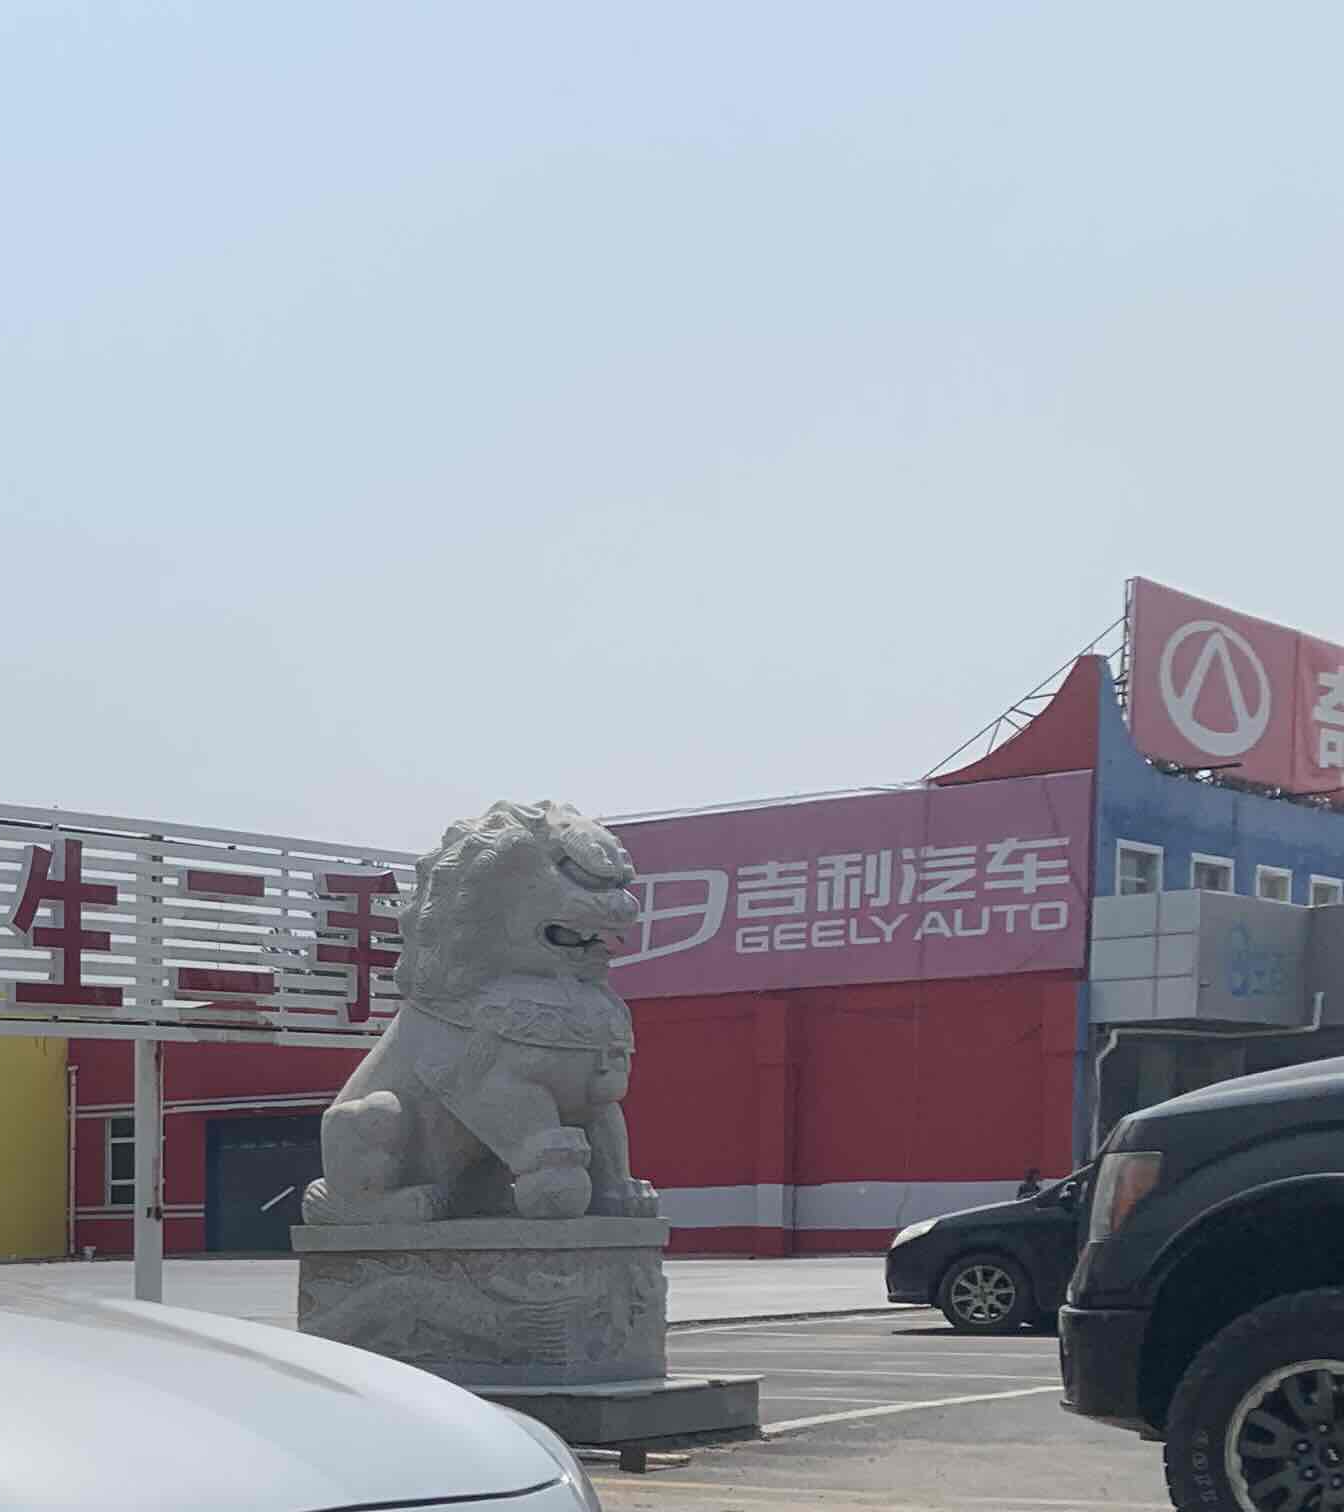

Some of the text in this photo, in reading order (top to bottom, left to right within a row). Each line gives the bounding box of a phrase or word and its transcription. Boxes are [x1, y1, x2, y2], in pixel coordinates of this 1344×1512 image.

[736, 836, 1071, 919] 吉利汽车
[735, 900, 1069, 954] GEELY AUTO
